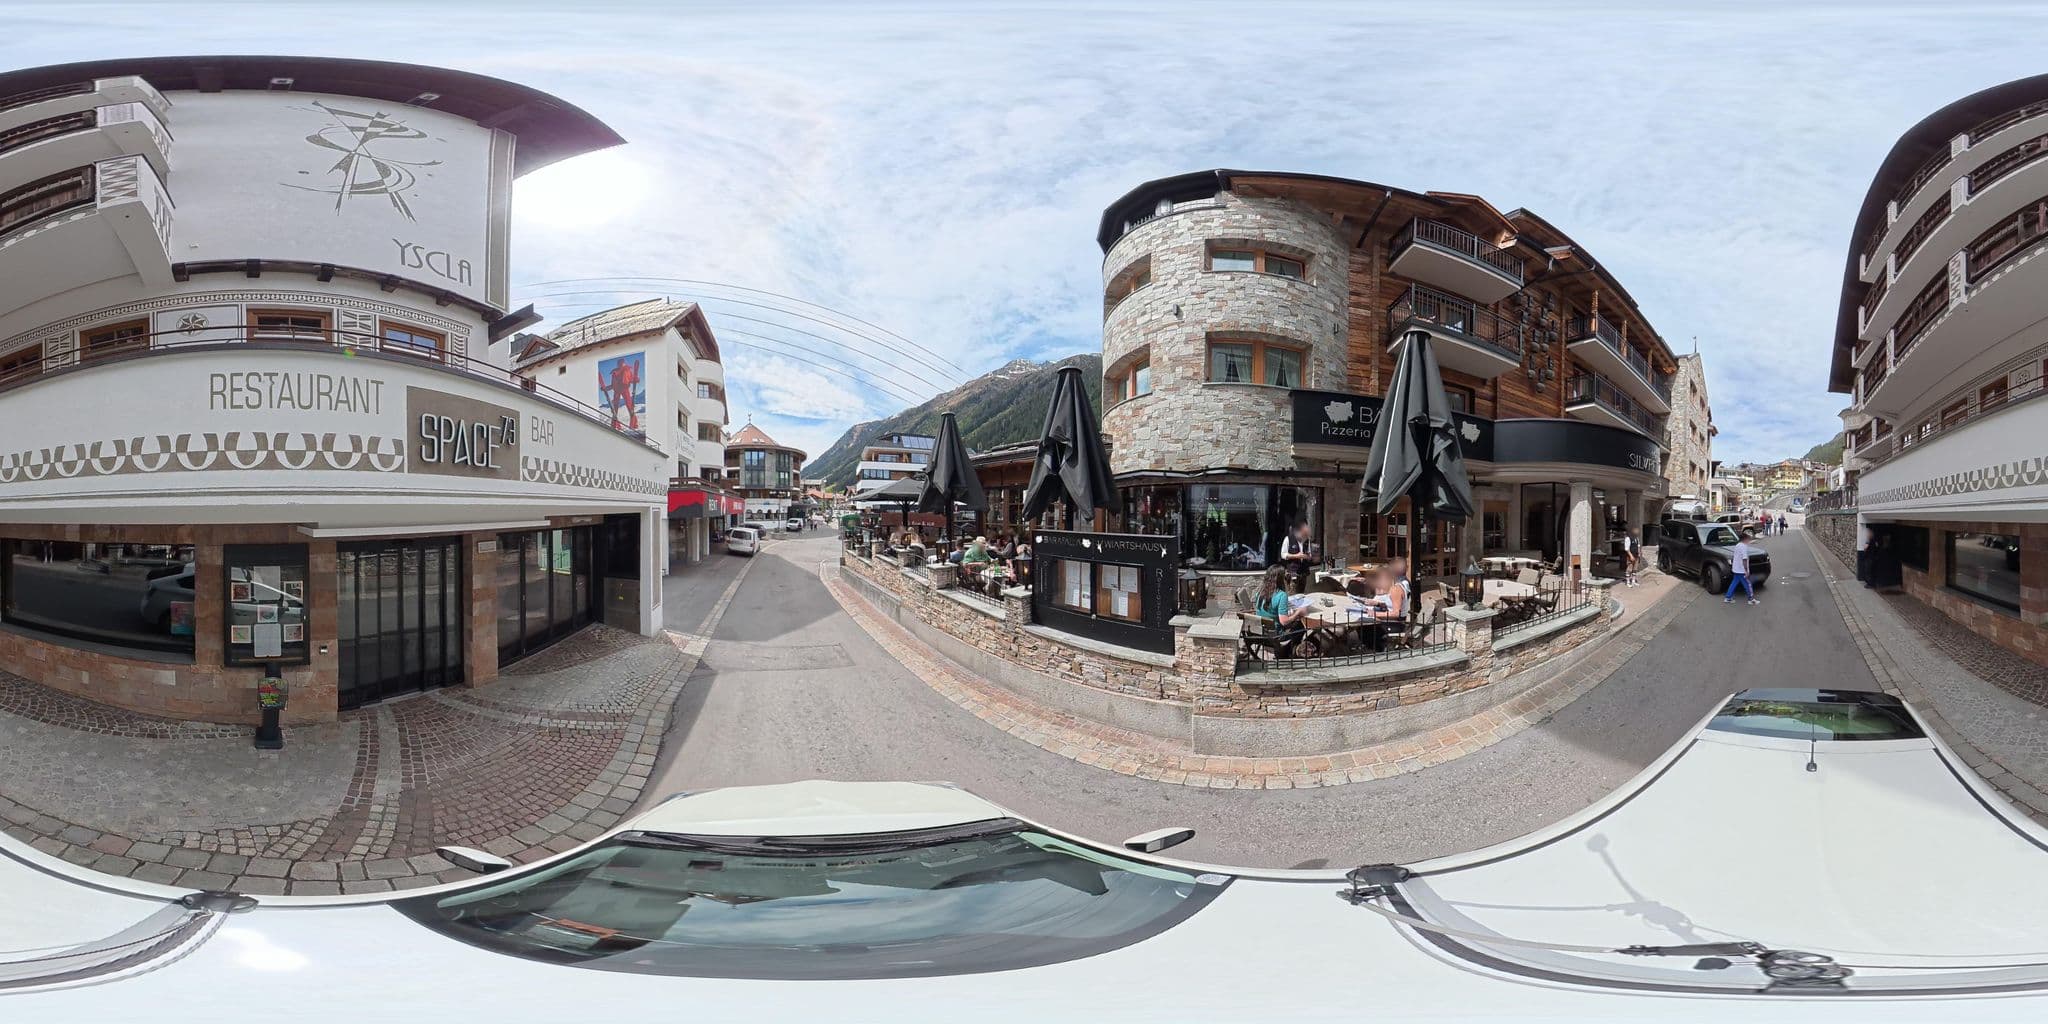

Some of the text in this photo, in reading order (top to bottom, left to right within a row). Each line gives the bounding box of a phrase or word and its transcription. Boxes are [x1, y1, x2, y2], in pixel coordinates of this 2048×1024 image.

[392, 238, 472, 287] YSCLA
[209, 371, 385, 415] RESTAURANT
[420, 413, 516, 470] SPACE 73
[531, 415, 555, 446] BAR
[1321, 422, 1371, 439] Pizzeria
